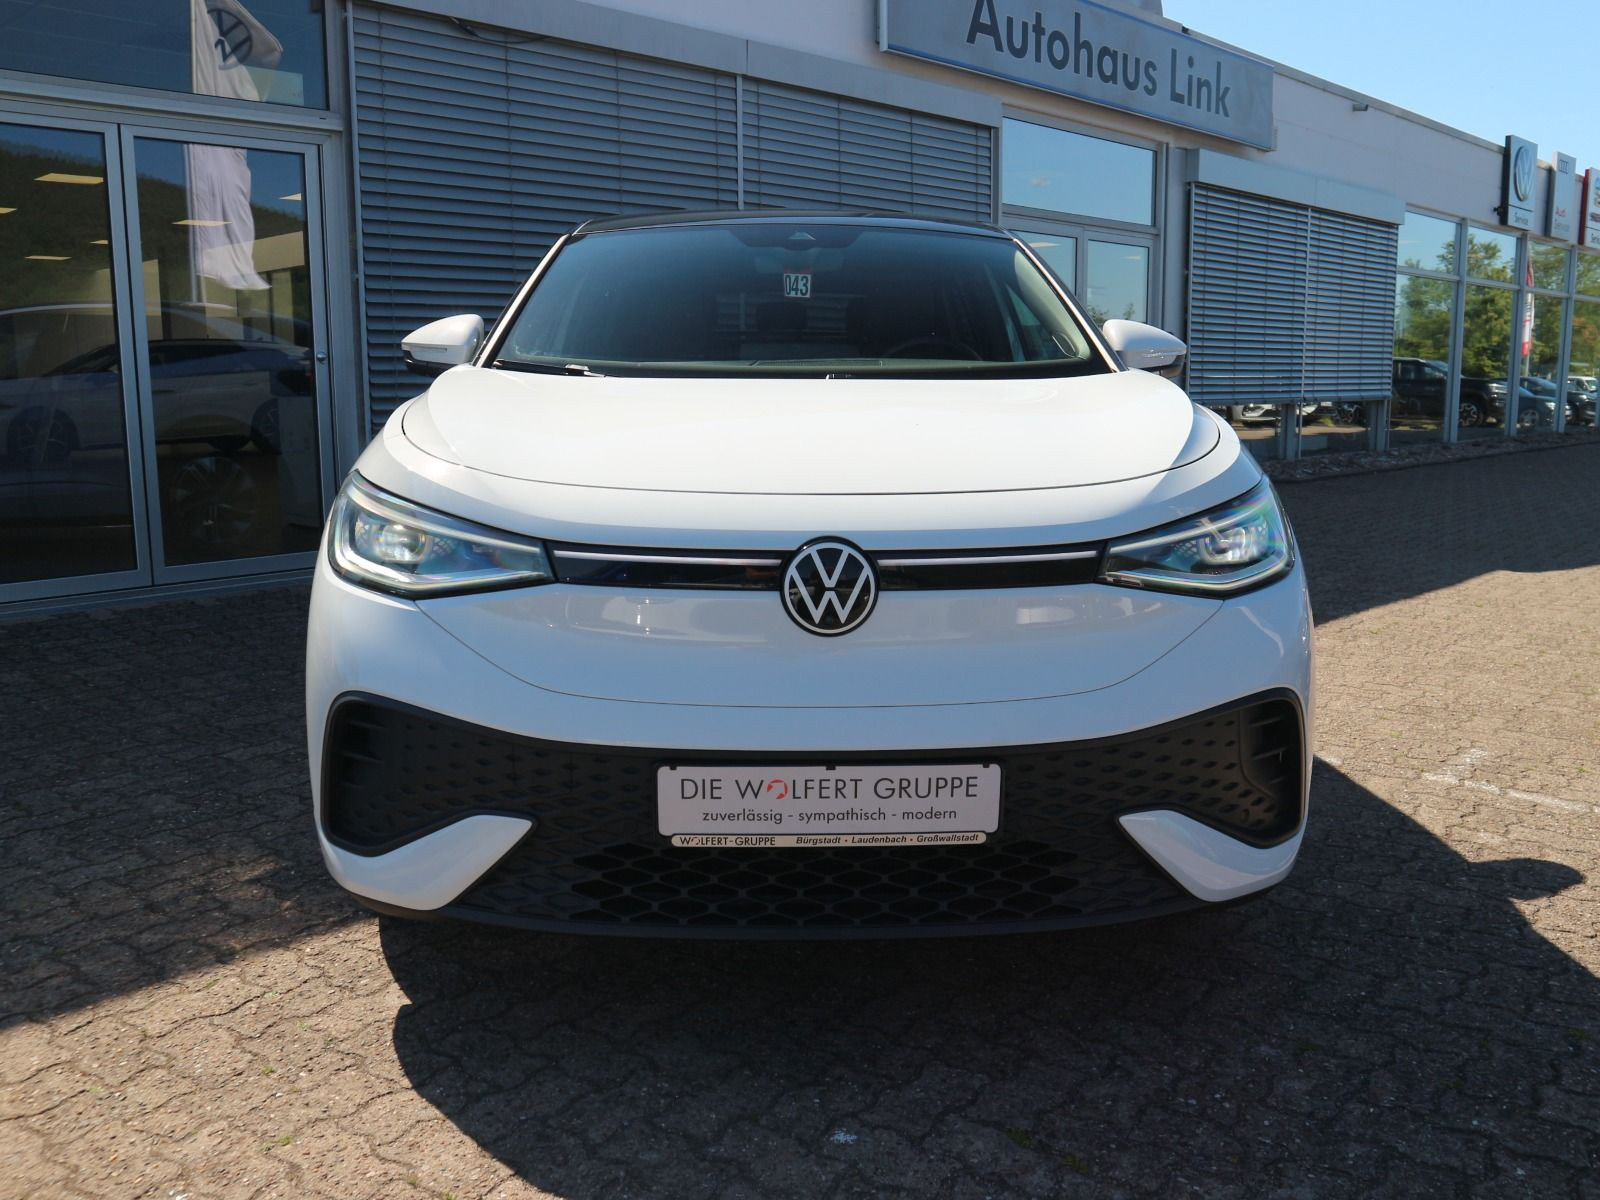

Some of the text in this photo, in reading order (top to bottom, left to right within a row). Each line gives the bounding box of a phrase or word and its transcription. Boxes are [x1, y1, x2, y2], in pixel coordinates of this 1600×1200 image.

[966, 0, 1231, 118] Autohaus Link
[784, 274, 809, 297] 043
[784, 542, 876, 634] VW
[681, 776, 978, 800] DIE WOLFERT GRUPPE
[702, 808, 783, 824] zuverlässig
[798, 807, 886, 824] sympathisch
[902, 806, 957, 820] modern
[796, 836, 841, 846] Bürgstadt
[851, 835, 907, 844] Laudenbach
[916, 834, 979, 843] Großwallstadt
